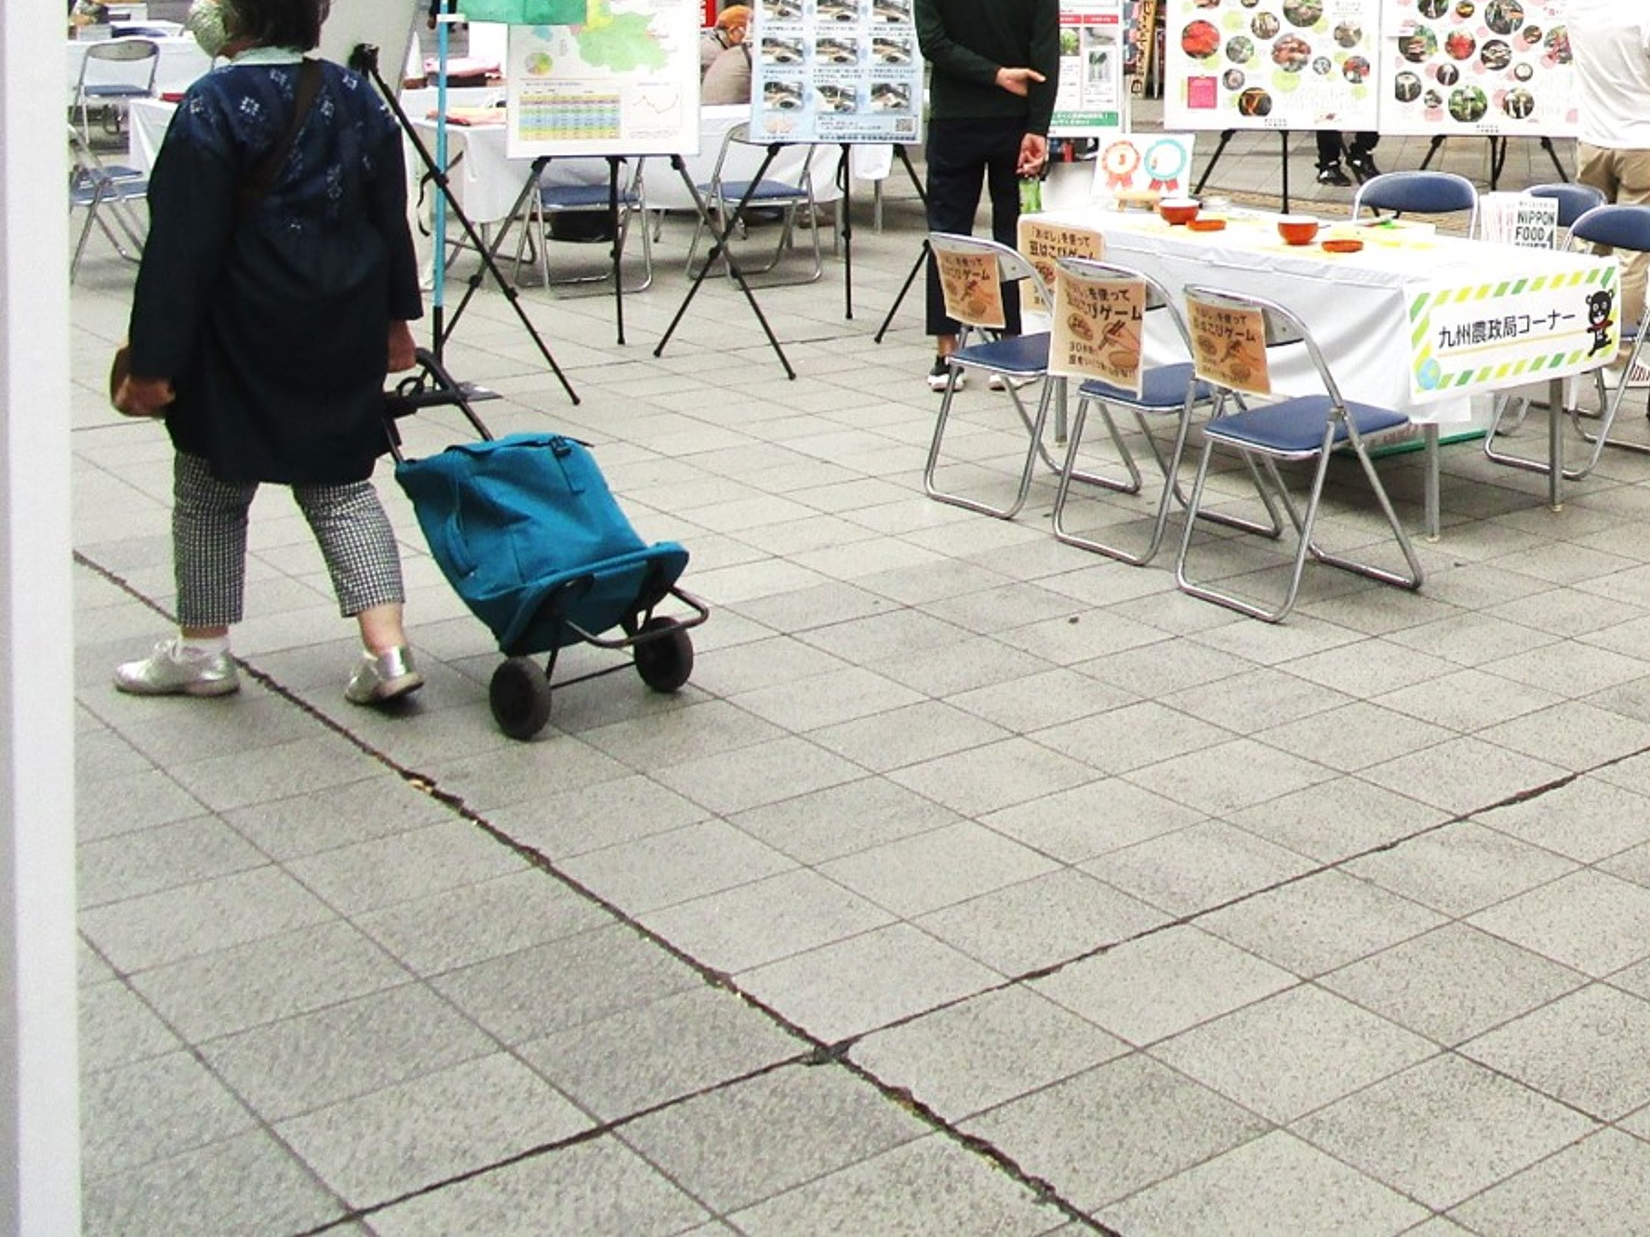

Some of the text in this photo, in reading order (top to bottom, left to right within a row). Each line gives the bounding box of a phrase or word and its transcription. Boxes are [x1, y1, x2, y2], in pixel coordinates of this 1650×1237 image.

[1517, 209, 1555, 226] NIPPON
[1515, 226, 1545, 241] FOOD
[1438, 308, 1576, 349] 九州農政局コーナー
